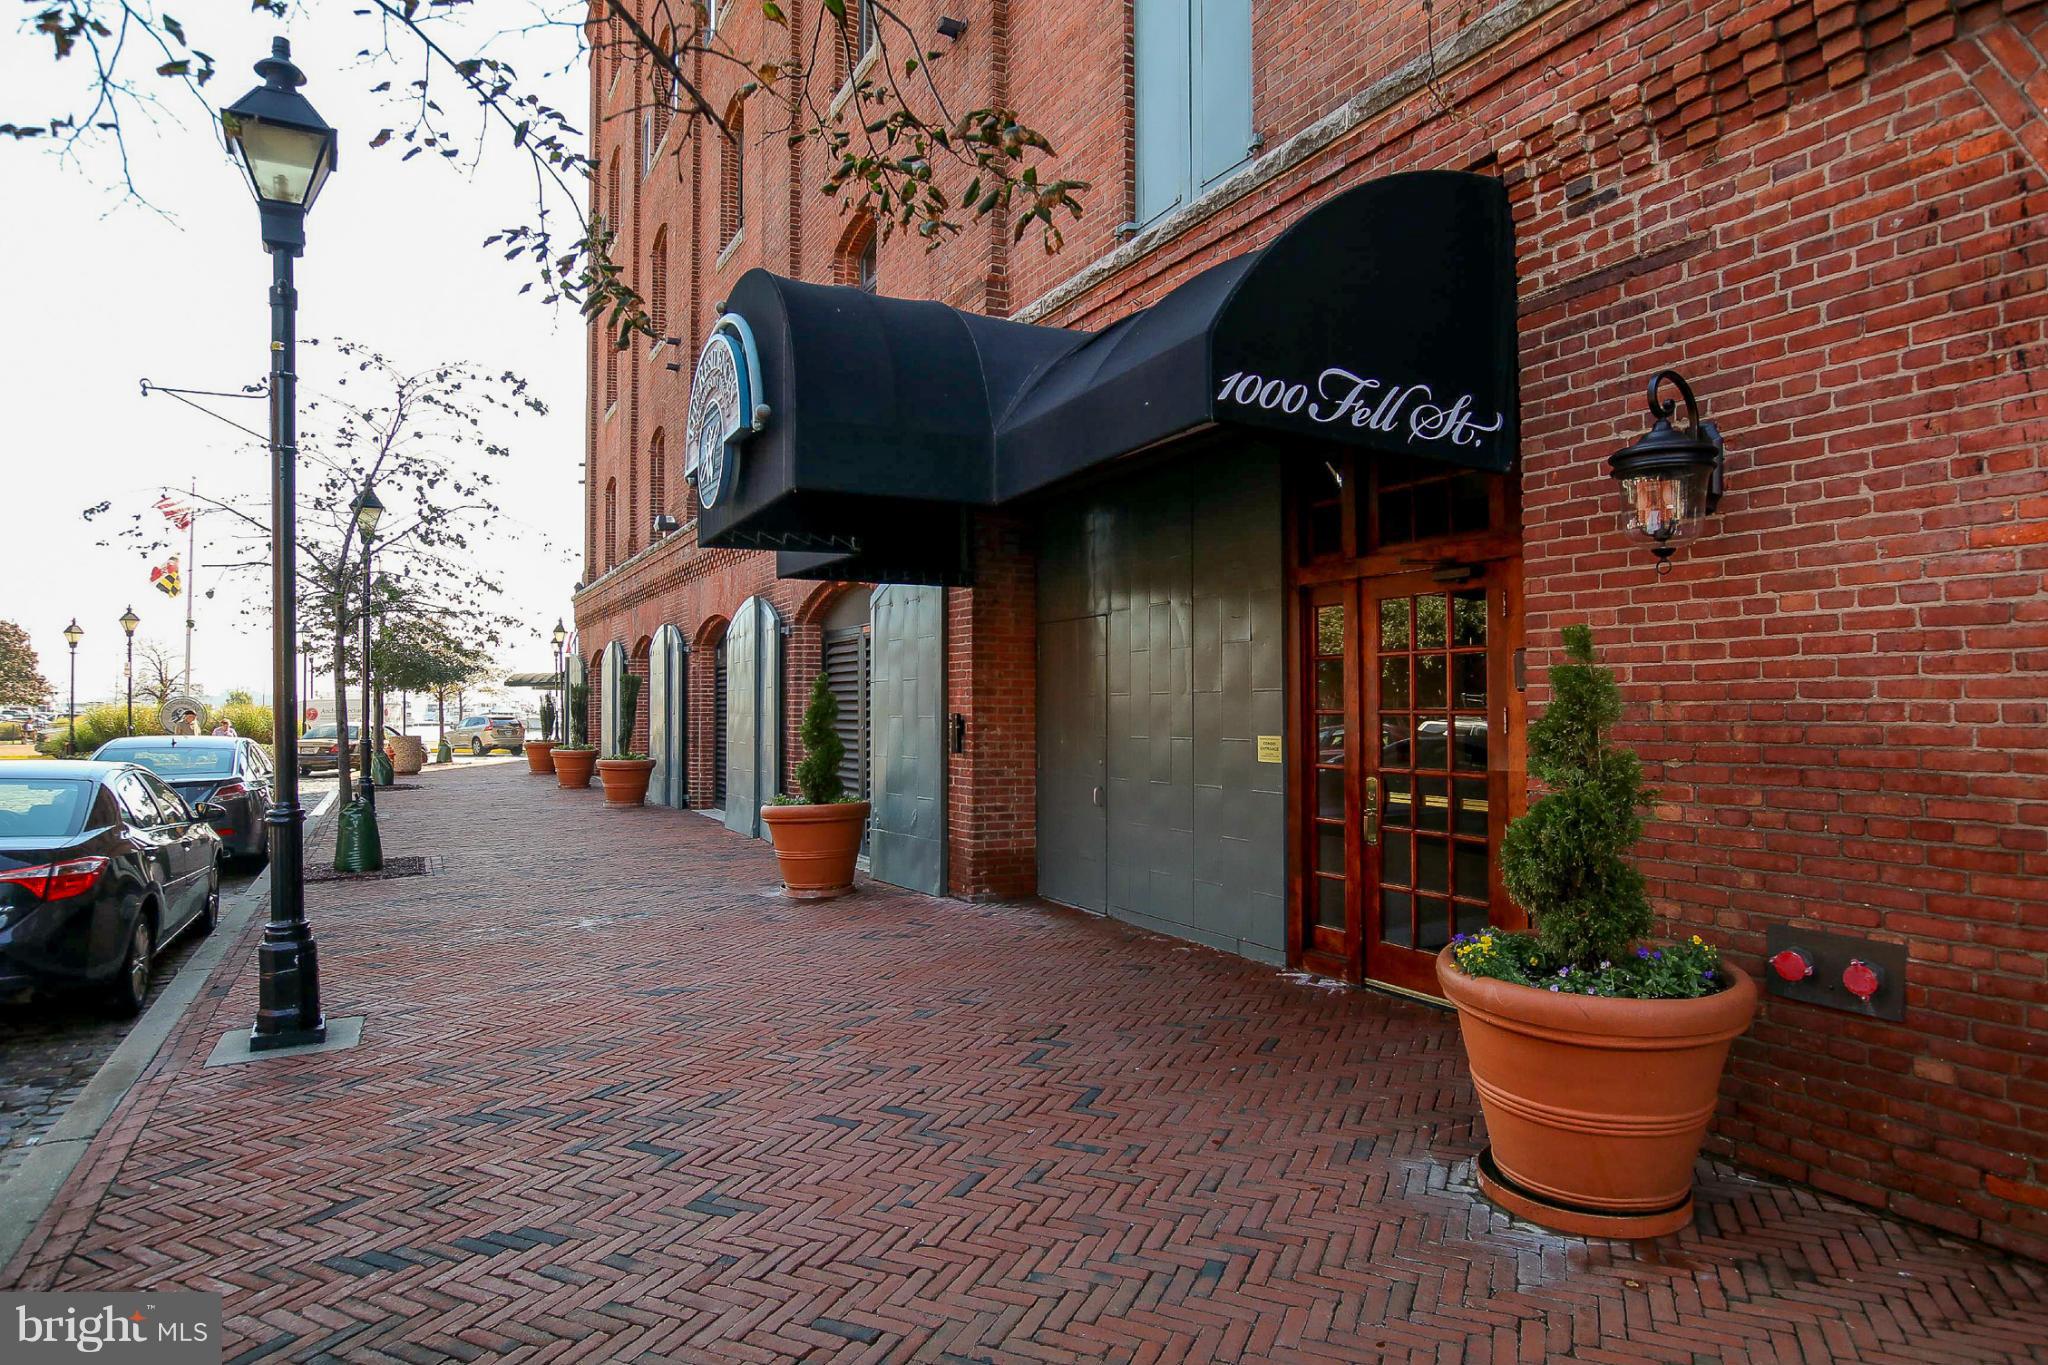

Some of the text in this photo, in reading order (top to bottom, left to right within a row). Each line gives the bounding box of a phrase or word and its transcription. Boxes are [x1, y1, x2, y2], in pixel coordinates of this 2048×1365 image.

[1217, 368, 1503, 447] 1000 Fell St.
